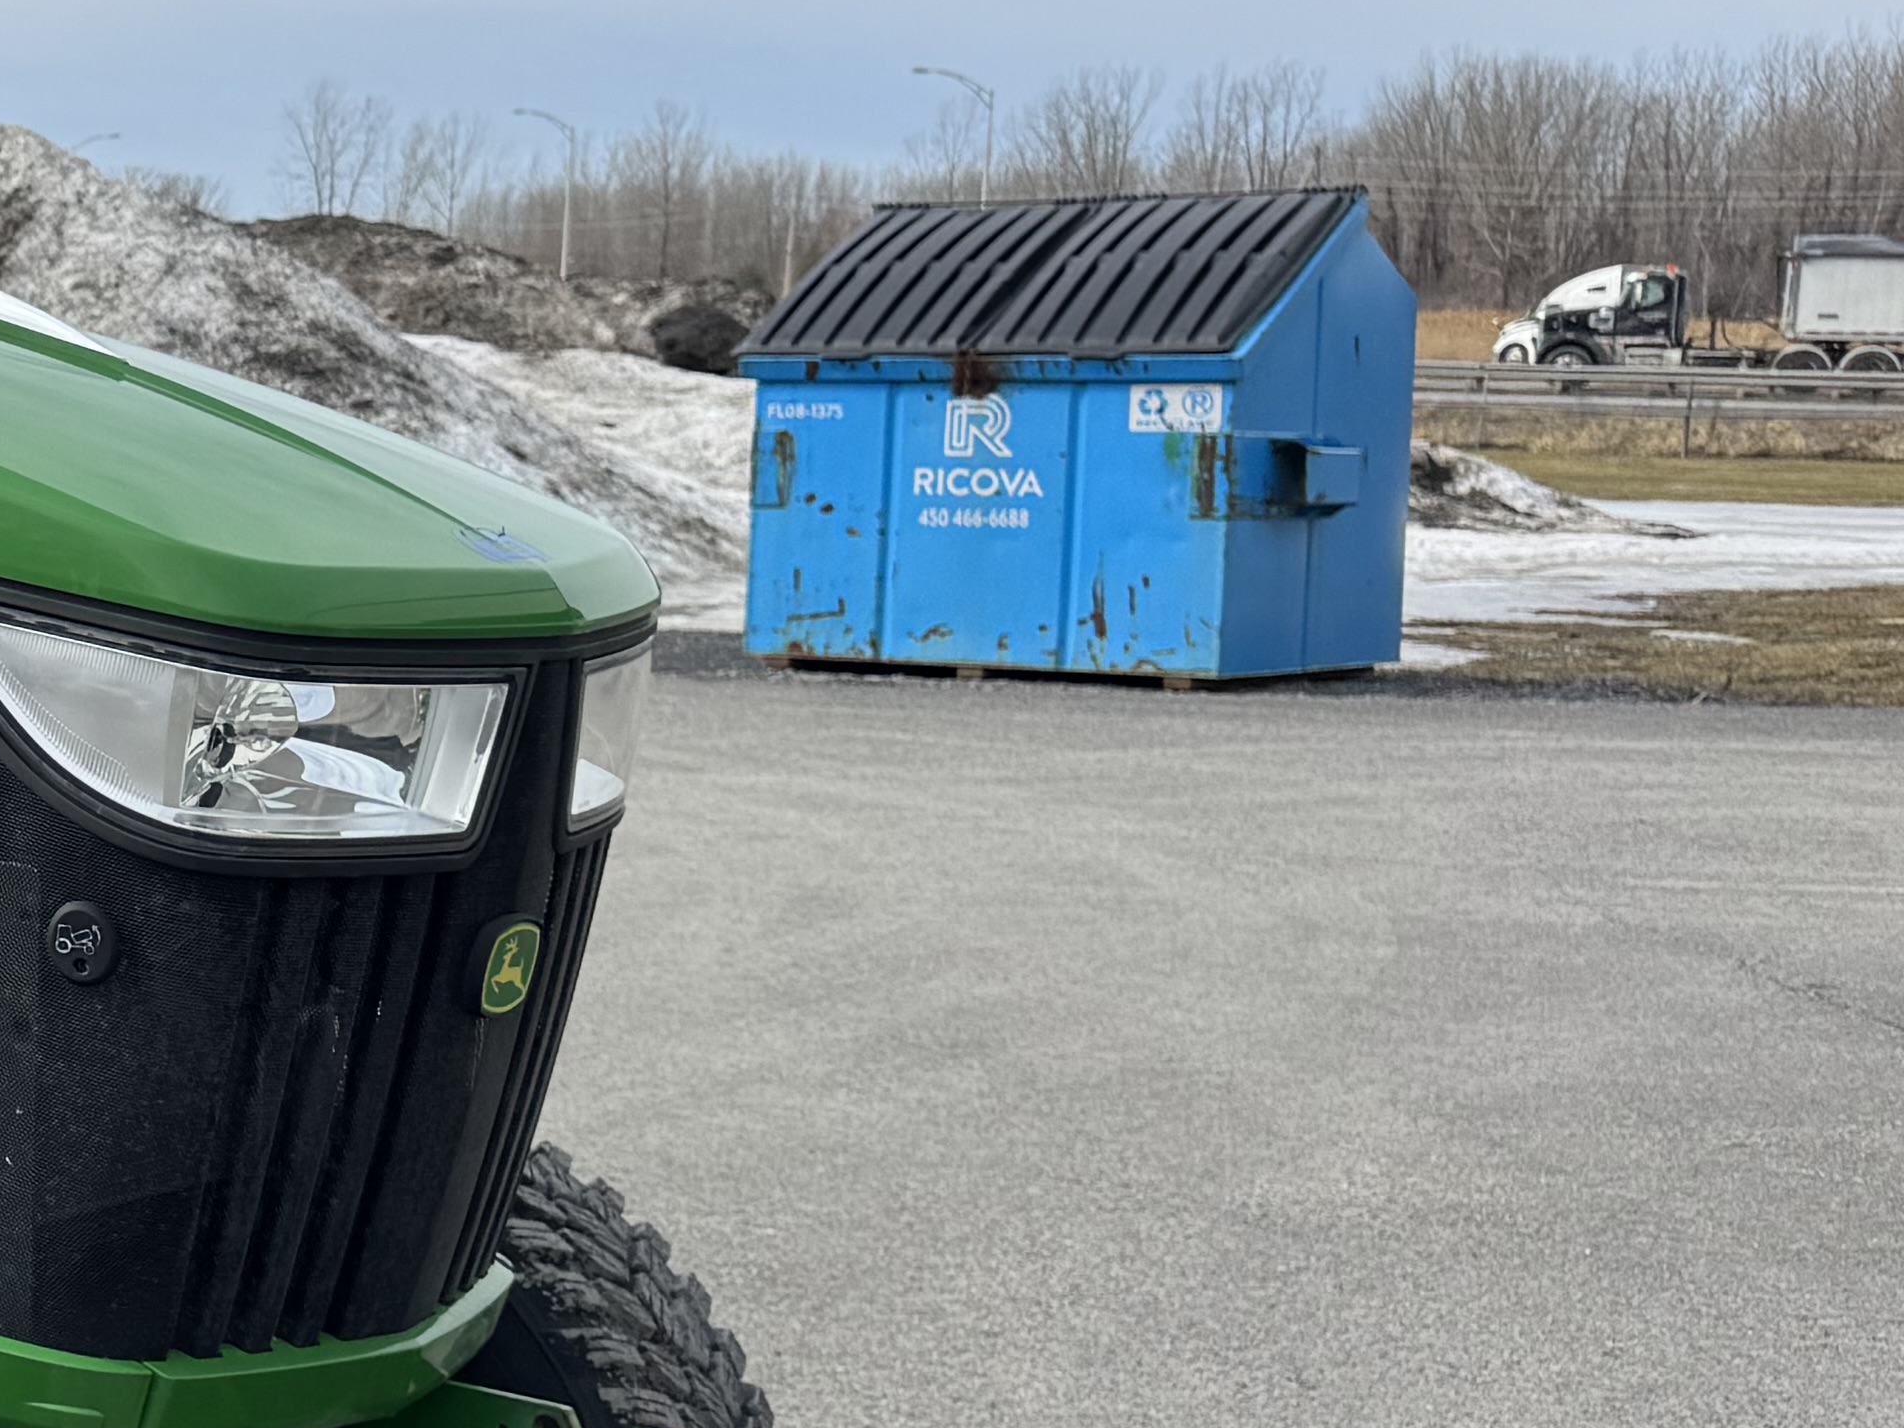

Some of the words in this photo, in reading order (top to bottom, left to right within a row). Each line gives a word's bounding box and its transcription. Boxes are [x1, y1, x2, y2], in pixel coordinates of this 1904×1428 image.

[767, 402, 844, 420] FL08-1375
[912, 468, 1043, 497] RICOVA
[918, 508, 949, 528] 450
[952, 508, 1031, 529] 466-6688
